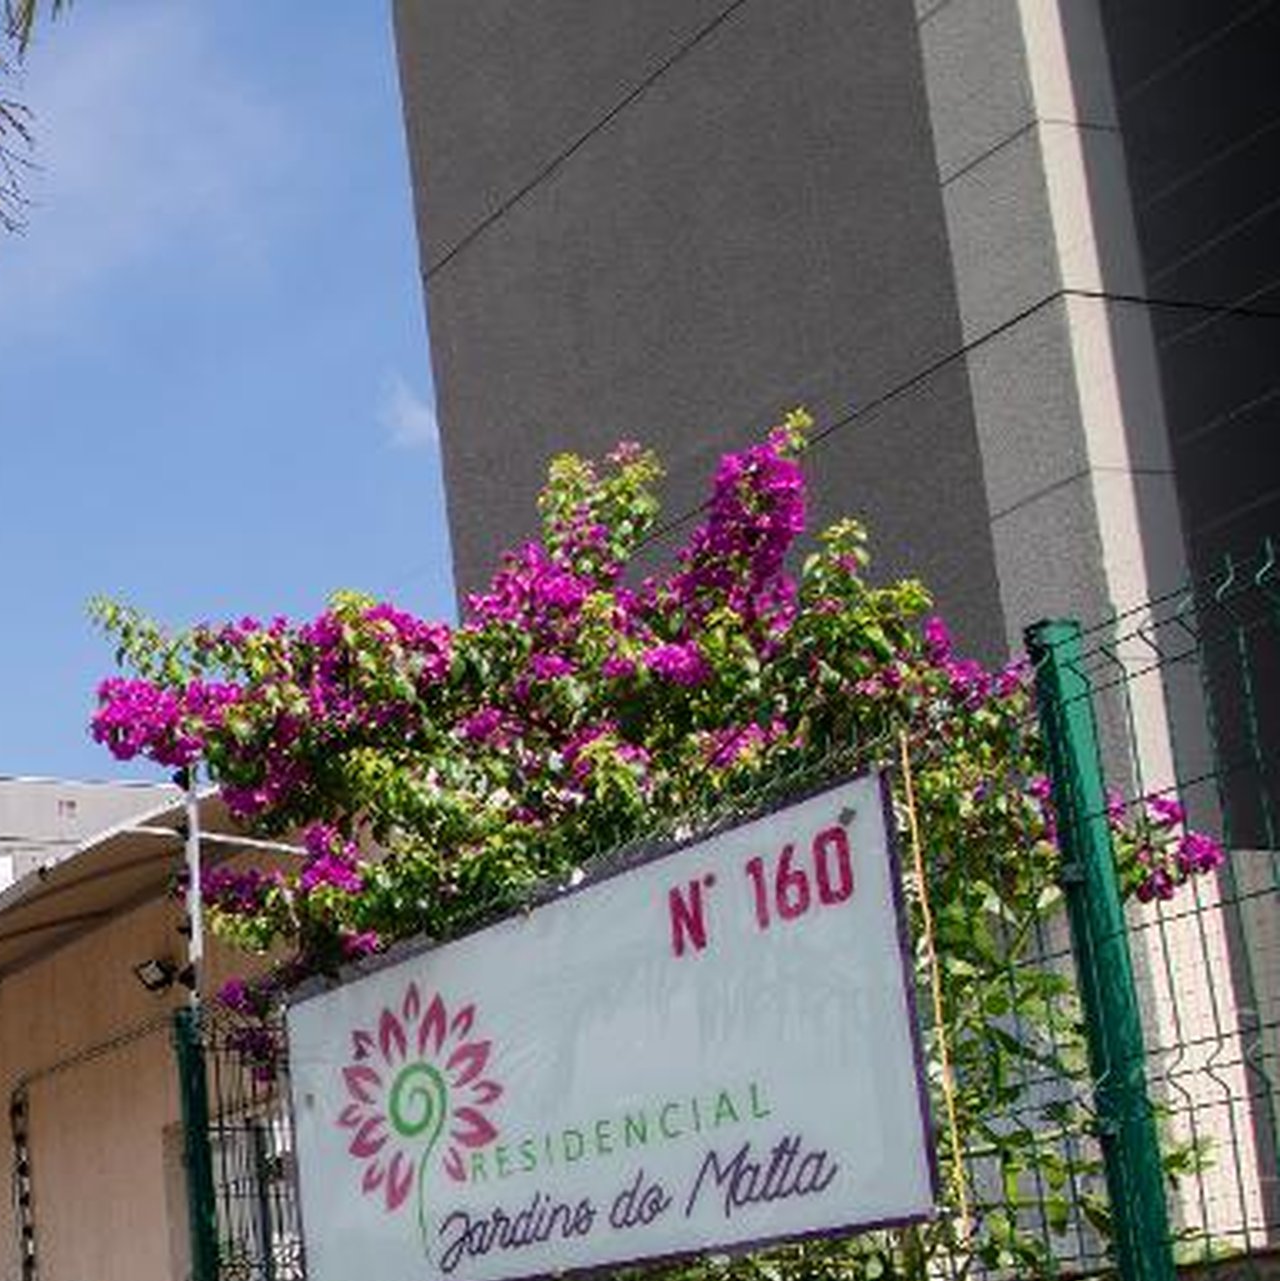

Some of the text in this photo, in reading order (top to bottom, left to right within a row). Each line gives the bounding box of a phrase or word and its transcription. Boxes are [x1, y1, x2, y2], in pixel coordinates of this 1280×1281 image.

[746, 827, 854, 929] 160
[471, 1082, 773, 1184] RESIDENCIAL
[439, 1189, 598, 1274] Jardins
[685, 1133, 839, 1219] Matta
